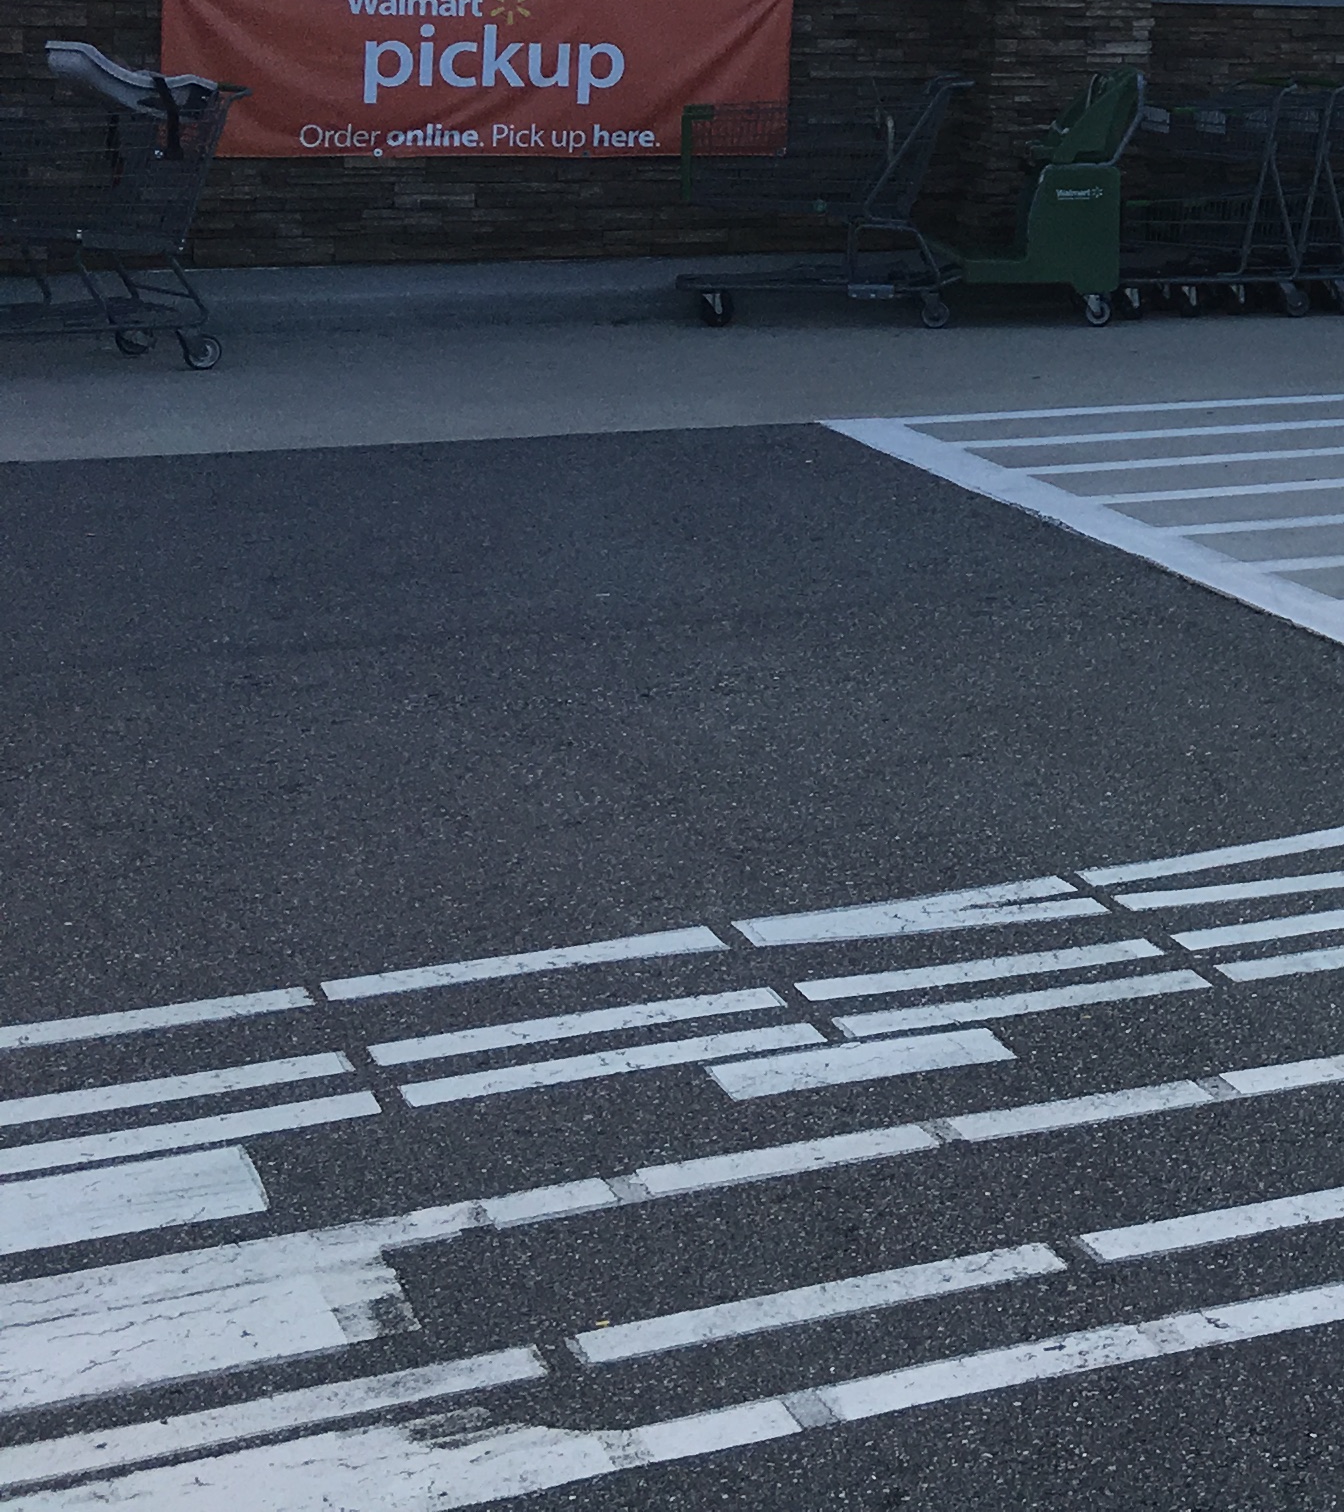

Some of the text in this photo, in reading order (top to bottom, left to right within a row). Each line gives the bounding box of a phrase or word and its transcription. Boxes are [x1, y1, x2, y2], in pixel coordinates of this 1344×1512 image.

[363, 24, 625, 105] pickup
[300, 124, 661, 154] Order online. Pick up here.
